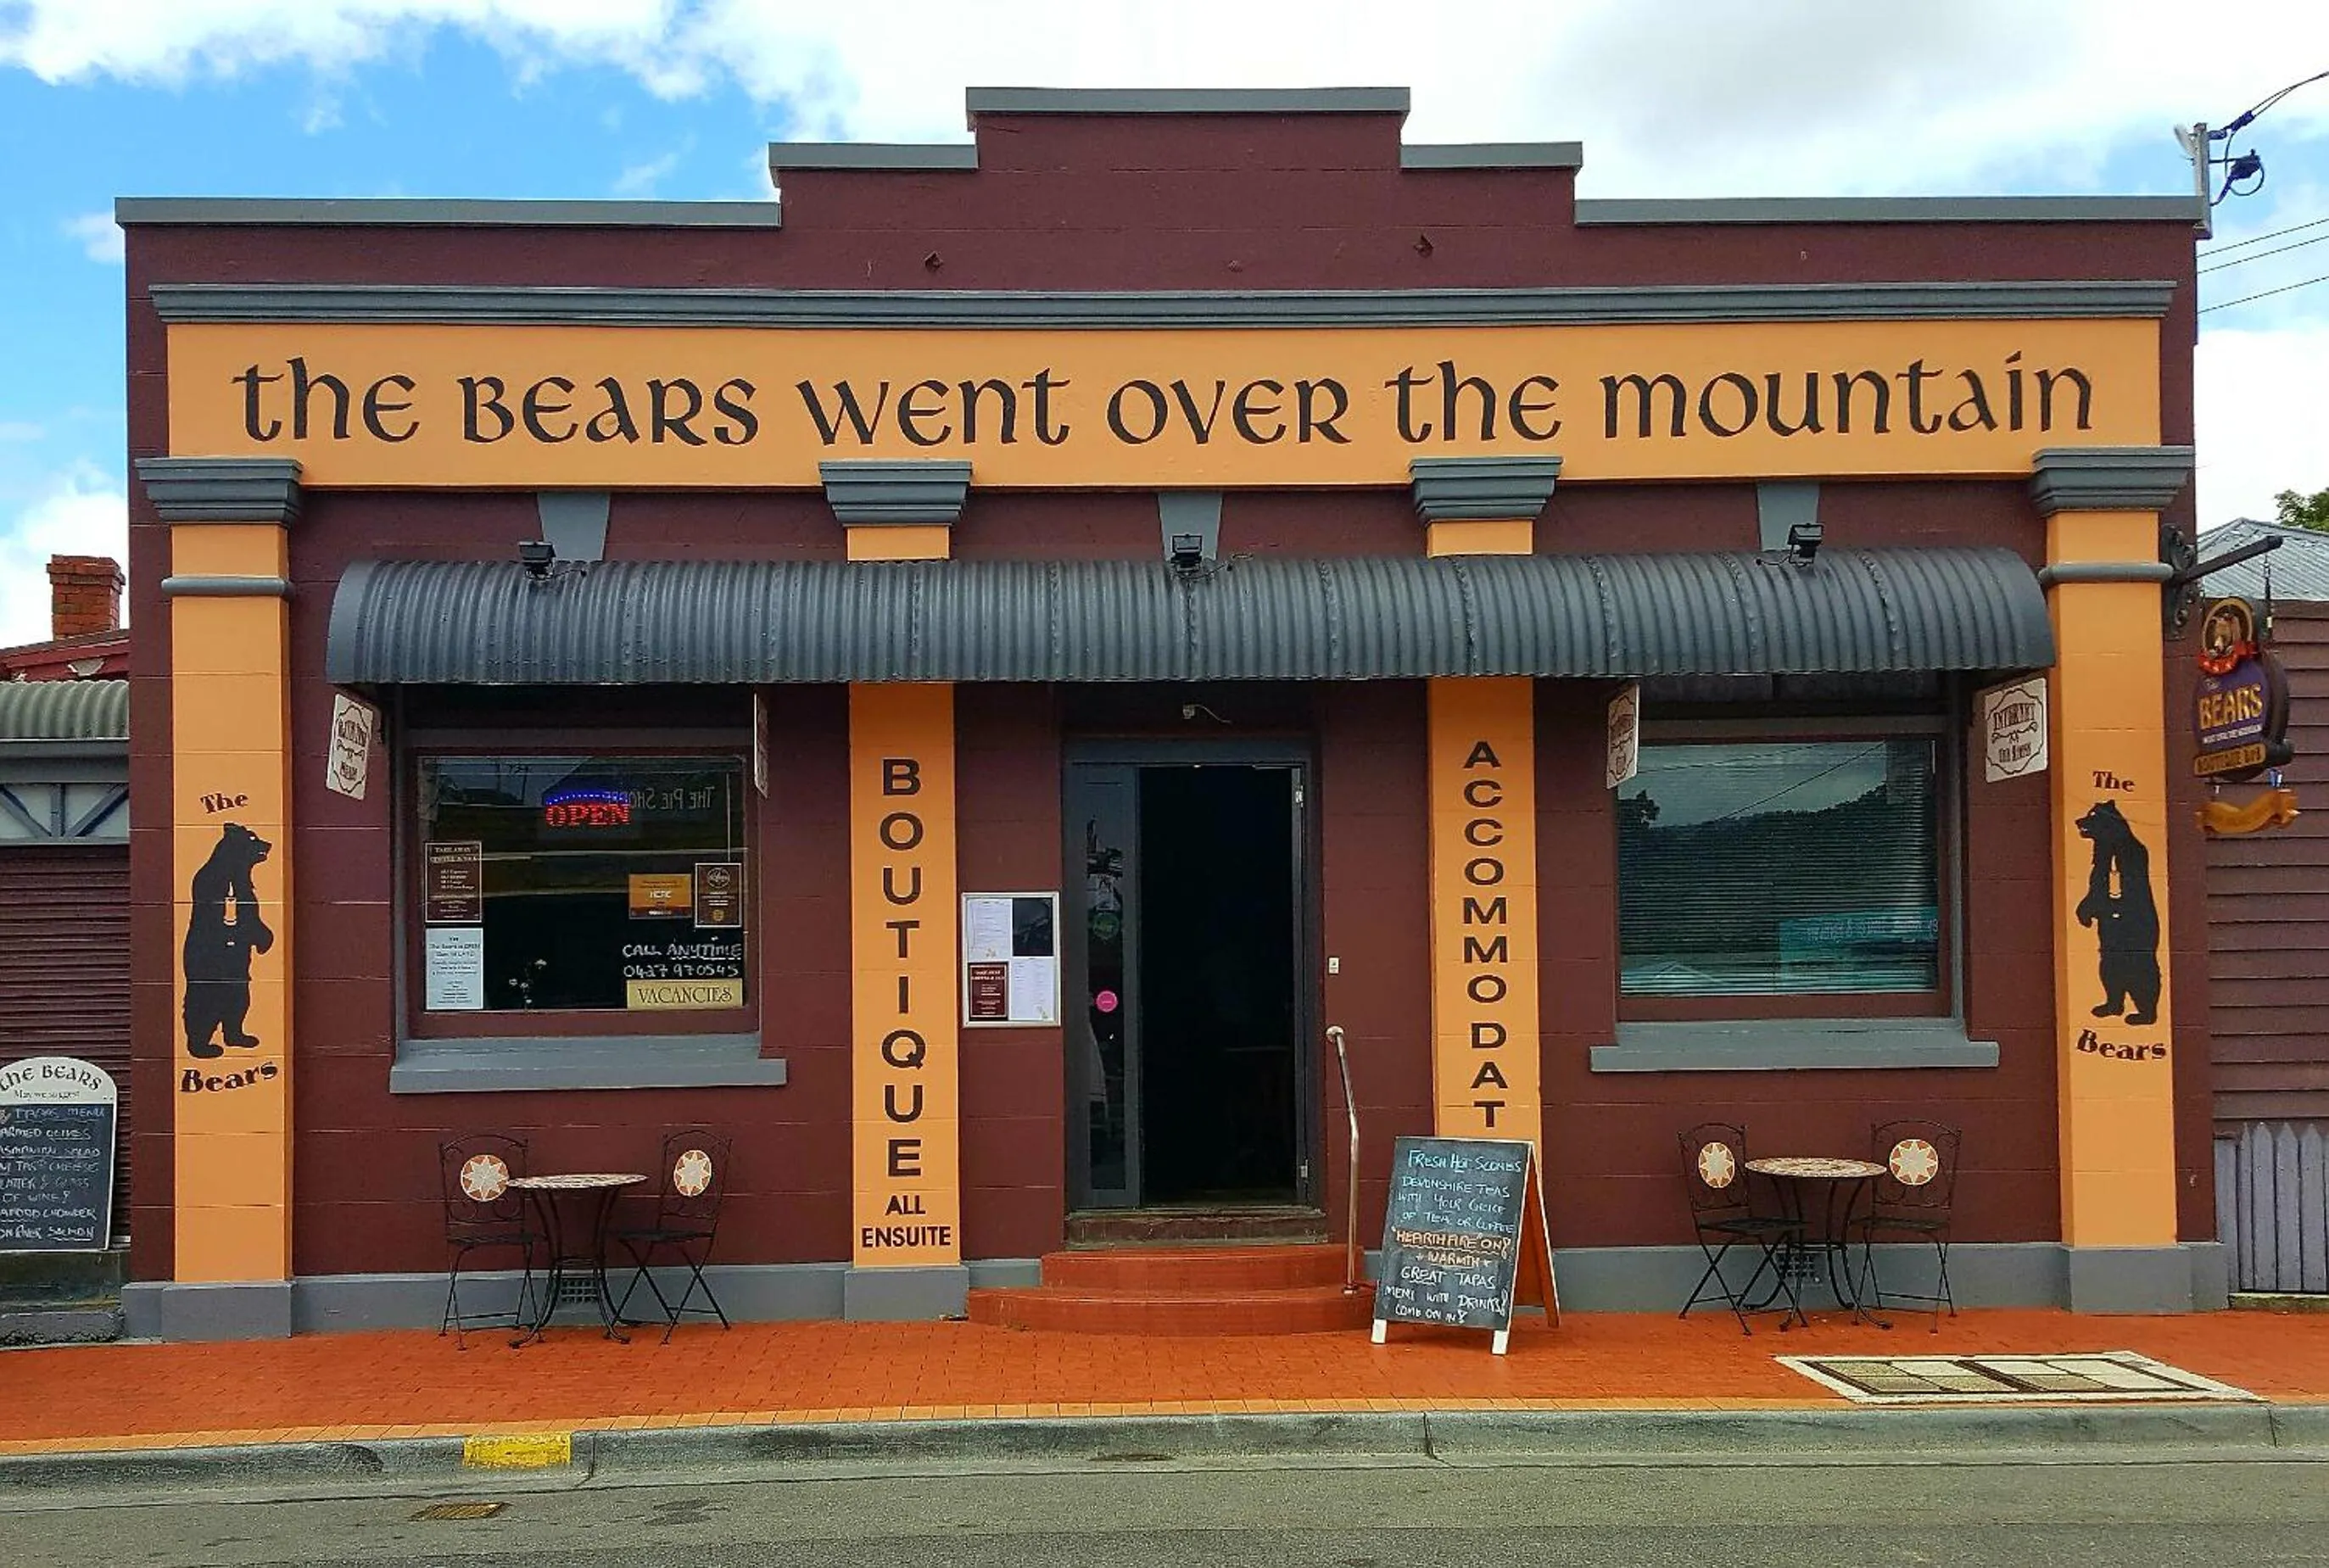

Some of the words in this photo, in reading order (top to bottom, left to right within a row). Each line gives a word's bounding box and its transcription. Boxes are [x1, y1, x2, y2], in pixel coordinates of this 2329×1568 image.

[2198, 683, 2263, 730] BEARS
[2092, 770, 2136, 793] The
[199, 791, 249, 815] The
[545, 804, 631, 827] OPEN
[1461, 740, 1509, 1128] ACCOMMODAT
[622, 943, 662, 957] CALL
[667, 938, 743, 958] ANYTIME
[623, 963, 669, 979] 0427
[673, 963, 740, 978] 970545
[879, 757, 927, 1177] BOUTIQUE
[637, 986, 733, 1004] VACANCIES
[2076, 1029, 2167, 1061] Bears
[178, 1061, 279, 1094] Bears
[67, 1107, 105, 1118] MENU
[0, 1125, 42, 1139] ARMED
[1406, 1150, 1447, 1169] FRESH
[1449, 1152, 1470, 1171] HOT
[1476, 1156, 1522, 1174] SCONES
[1401, 1175, 1472, 1193] DEVONSHIRE
[1476, 1182, 1511, 1199] TEAS
[885, 1194, 926, 1216] ALL
[1398, 1191, 1422, 1204] WITH
[1434, 1193, 1462, 1211] YOUR
[1401, 1211, 1417, 1223] OF
[1423, 1211, 1451, 1225] TEA
[1457, 1216, 1472, 1228] OR
[1476, 1219, 1516, 1234] COFFEE
[862, 1225, 952, 1248] ENSUITE
[1427, 1250, 1482, 1267] WARMTH
[1400, 1265, 1448, 1285] GREAT
[1455, 1271, 1497, 1291] TAPAS
[1394, 1303, 1422, 1318] COME
[1425, 1307, 1443, 1320] ON
